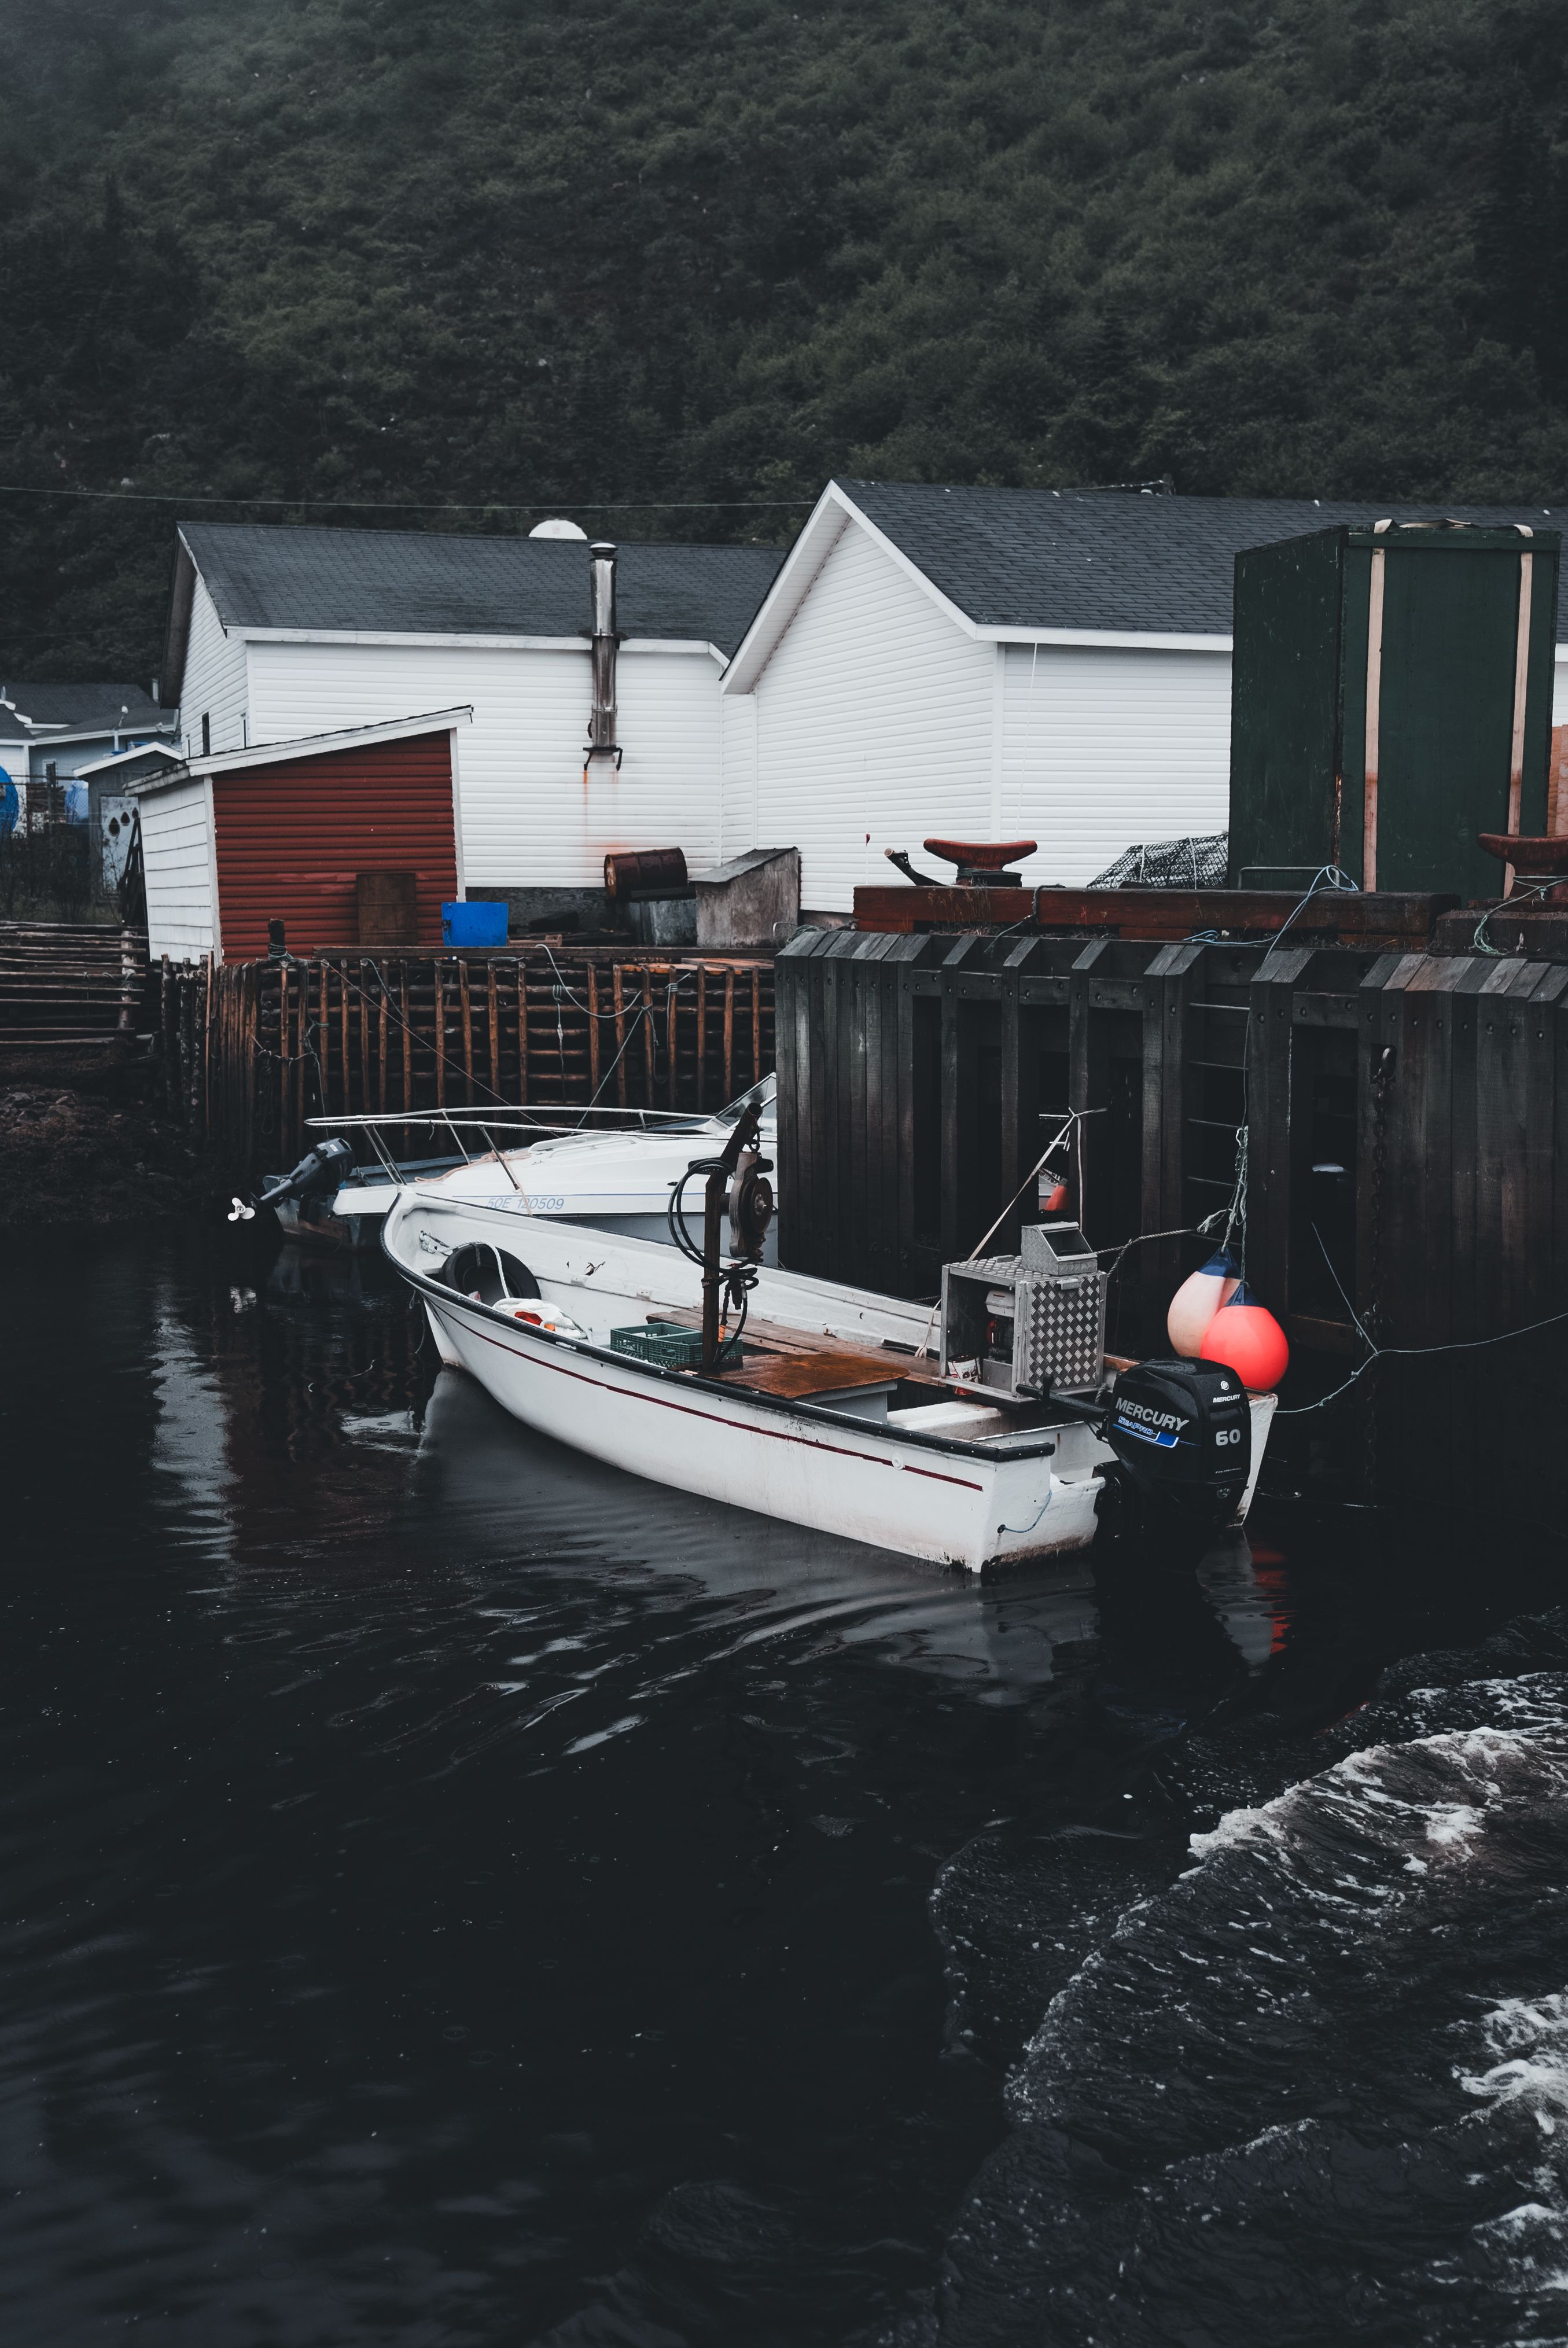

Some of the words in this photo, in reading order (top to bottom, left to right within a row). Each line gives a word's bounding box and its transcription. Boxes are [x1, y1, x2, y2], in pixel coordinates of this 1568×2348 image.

[517, 1198, 565, 1210] 120509
[1212, 1394, 1241, 1403] MERCURY
[1116, 1397, 1190, 1431] MERCURY
[1216, 1429, 1241, 1446] 60
